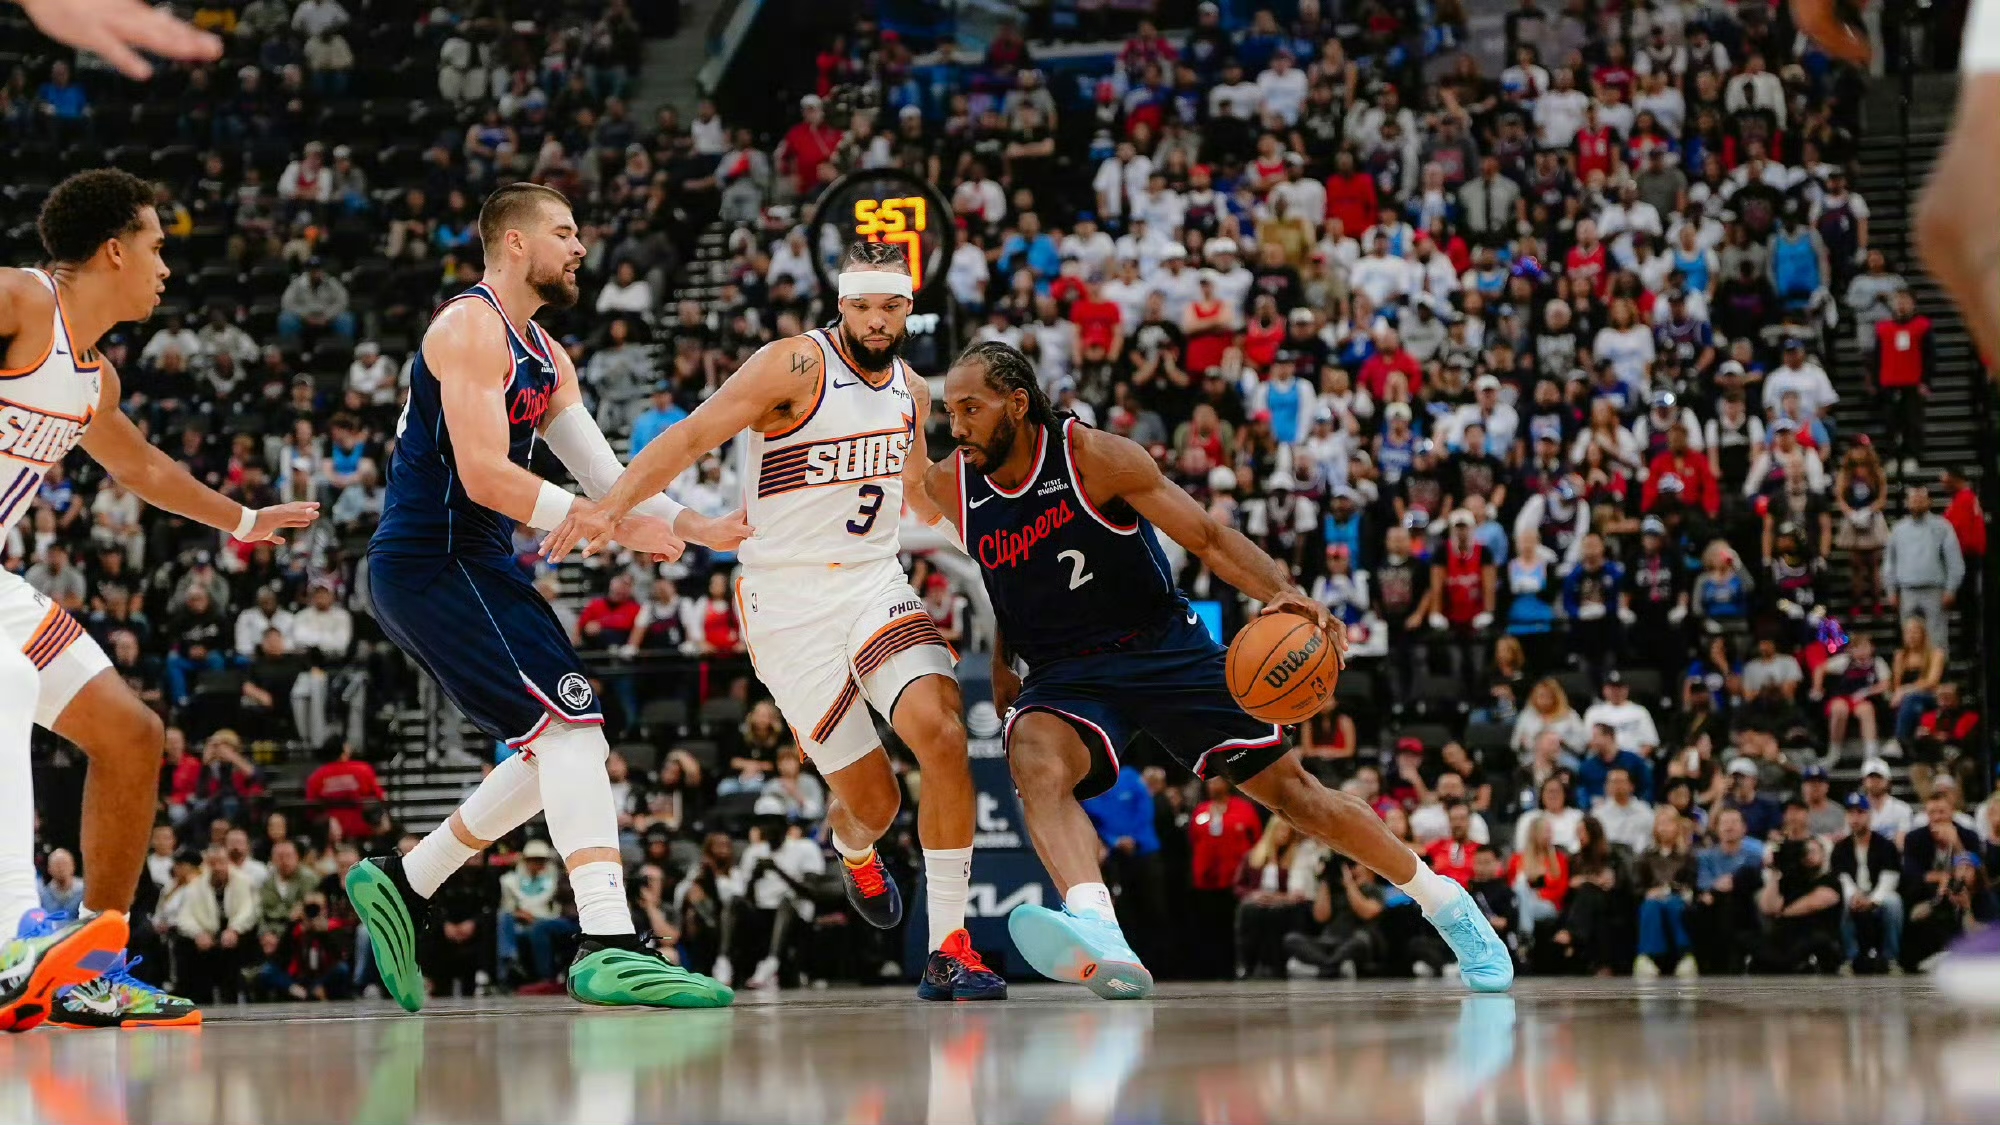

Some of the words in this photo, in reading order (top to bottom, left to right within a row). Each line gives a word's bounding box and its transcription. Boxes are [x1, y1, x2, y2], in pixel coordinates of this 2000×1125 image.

[867, 231, 922, 293] 7
[891, 386, 911, 400] PayPa
[0, 405, 80, 463] SUNS
[804, 432, 908, 485] SUNS
[1037, 482, 1070, 497] RWANDA
[1042, 477, 1061, 488] VISIT
[845, 484, 885, 537] 3
[978, 499, 1075, 570] Clippers
[1056, 549, 1094, 591] 2
[889, 600, 925, 618] PHOE
[1263, 634, 1323, 689] Wilson
